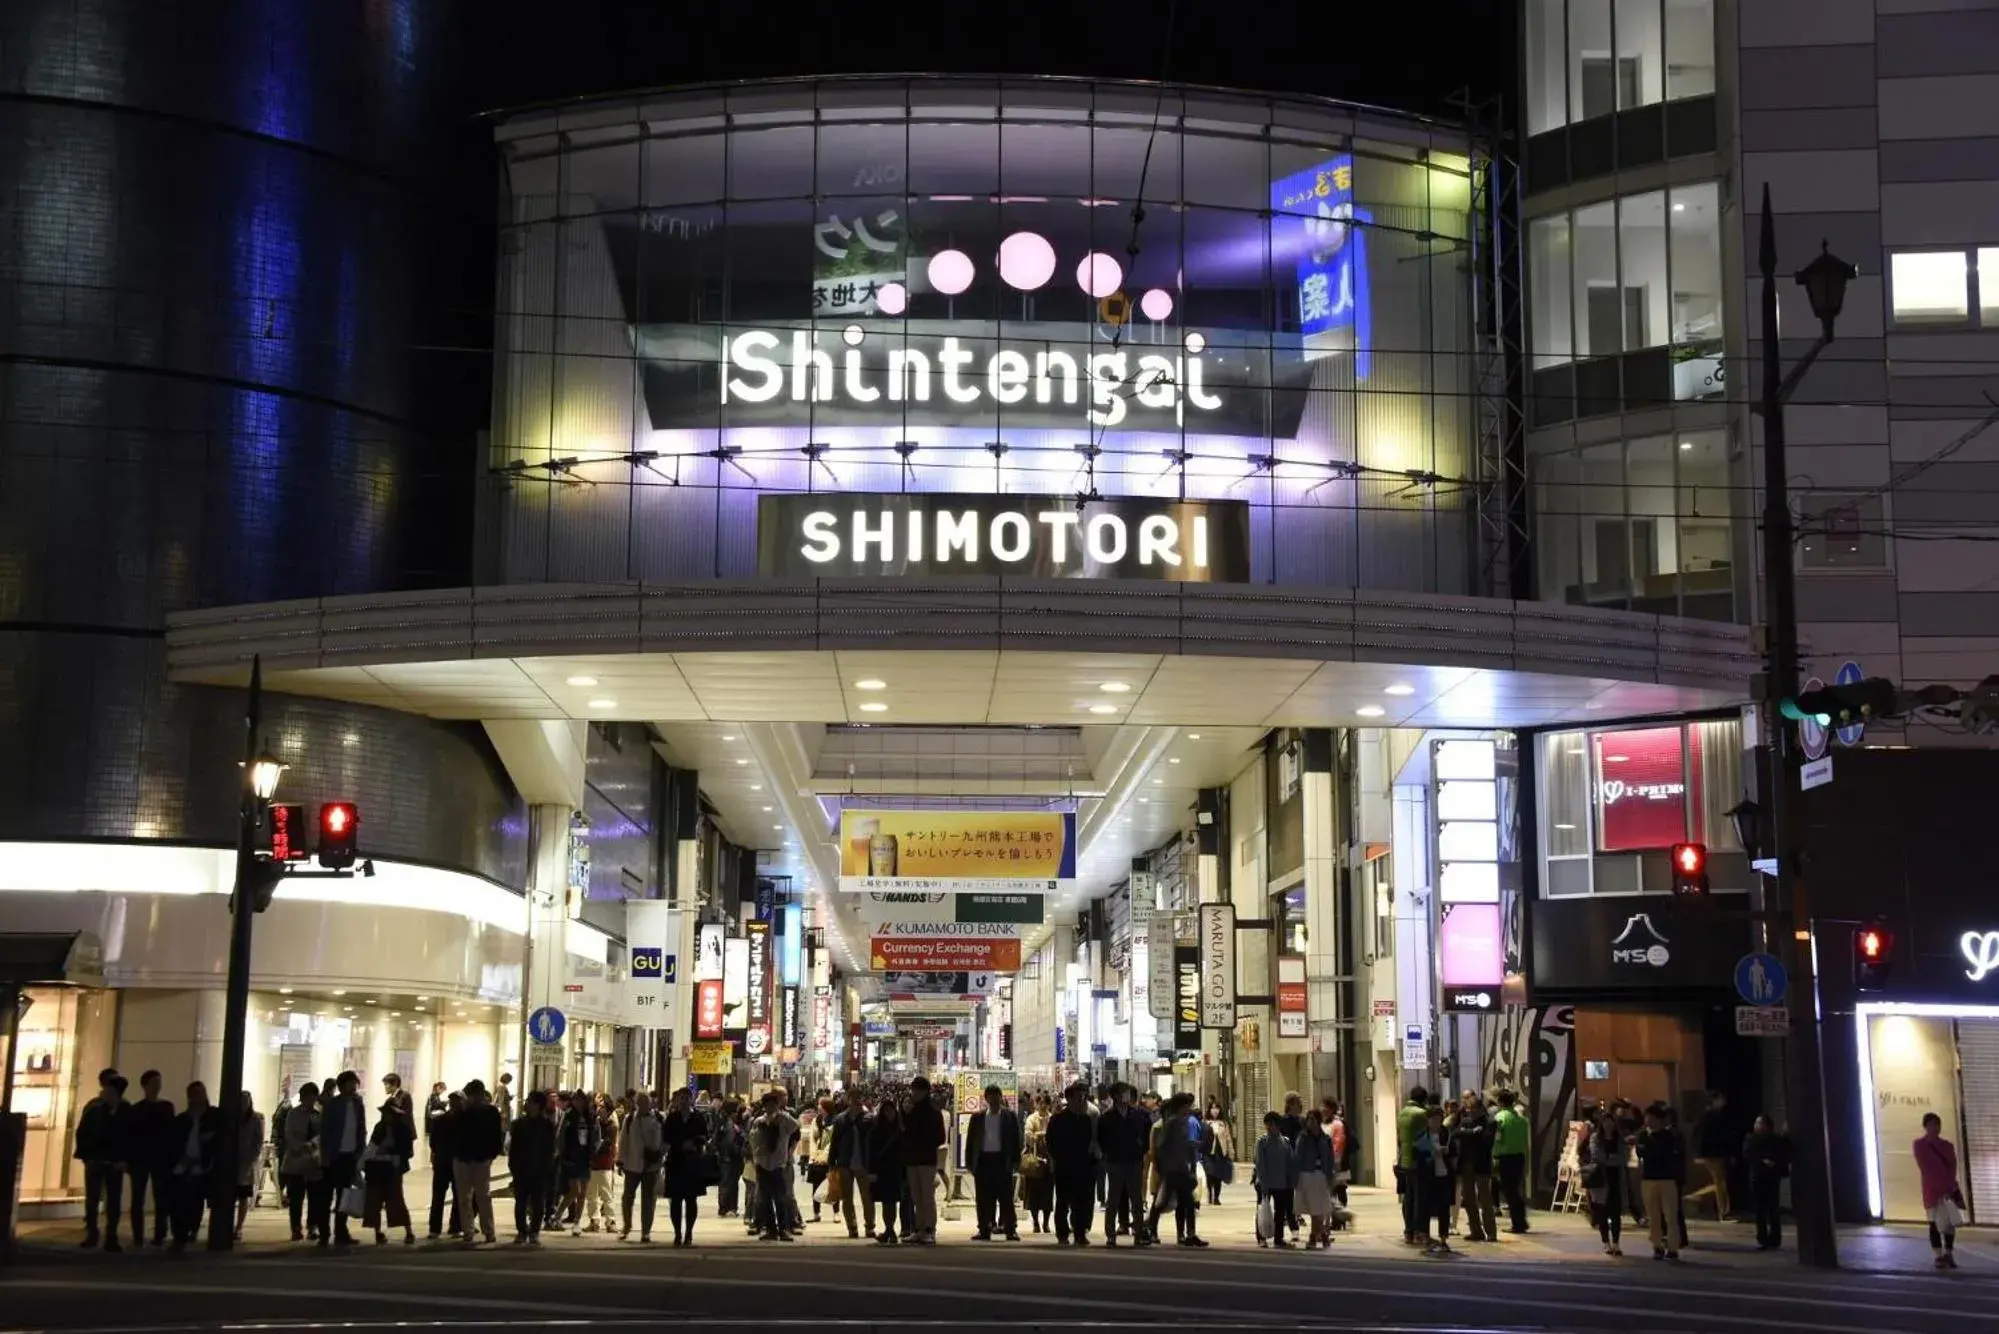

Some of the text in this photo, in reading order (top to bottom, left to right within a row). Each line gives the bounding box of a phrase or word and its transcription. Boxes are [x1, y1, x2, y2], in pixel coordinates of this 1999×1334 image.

[727, 324, 1222, 427] Shintengai
[800, 510, 1208, 568] SHIMOTORI
[905, 830, 1054, 844] サントリー九州熊本工場で
[886, 893, 927, 903] HANDS
[896, 923, 1014, 935] KUMAMOTO BANK
[883, 942, 991, 955] Currency Exchange
[1211, 909, 1225, 998] MARUTA GO
[633, 956, 661, 970] GU
[637, 996, 655, 1006] B1F
[1211, 1014, 1225, 1024] 2F
